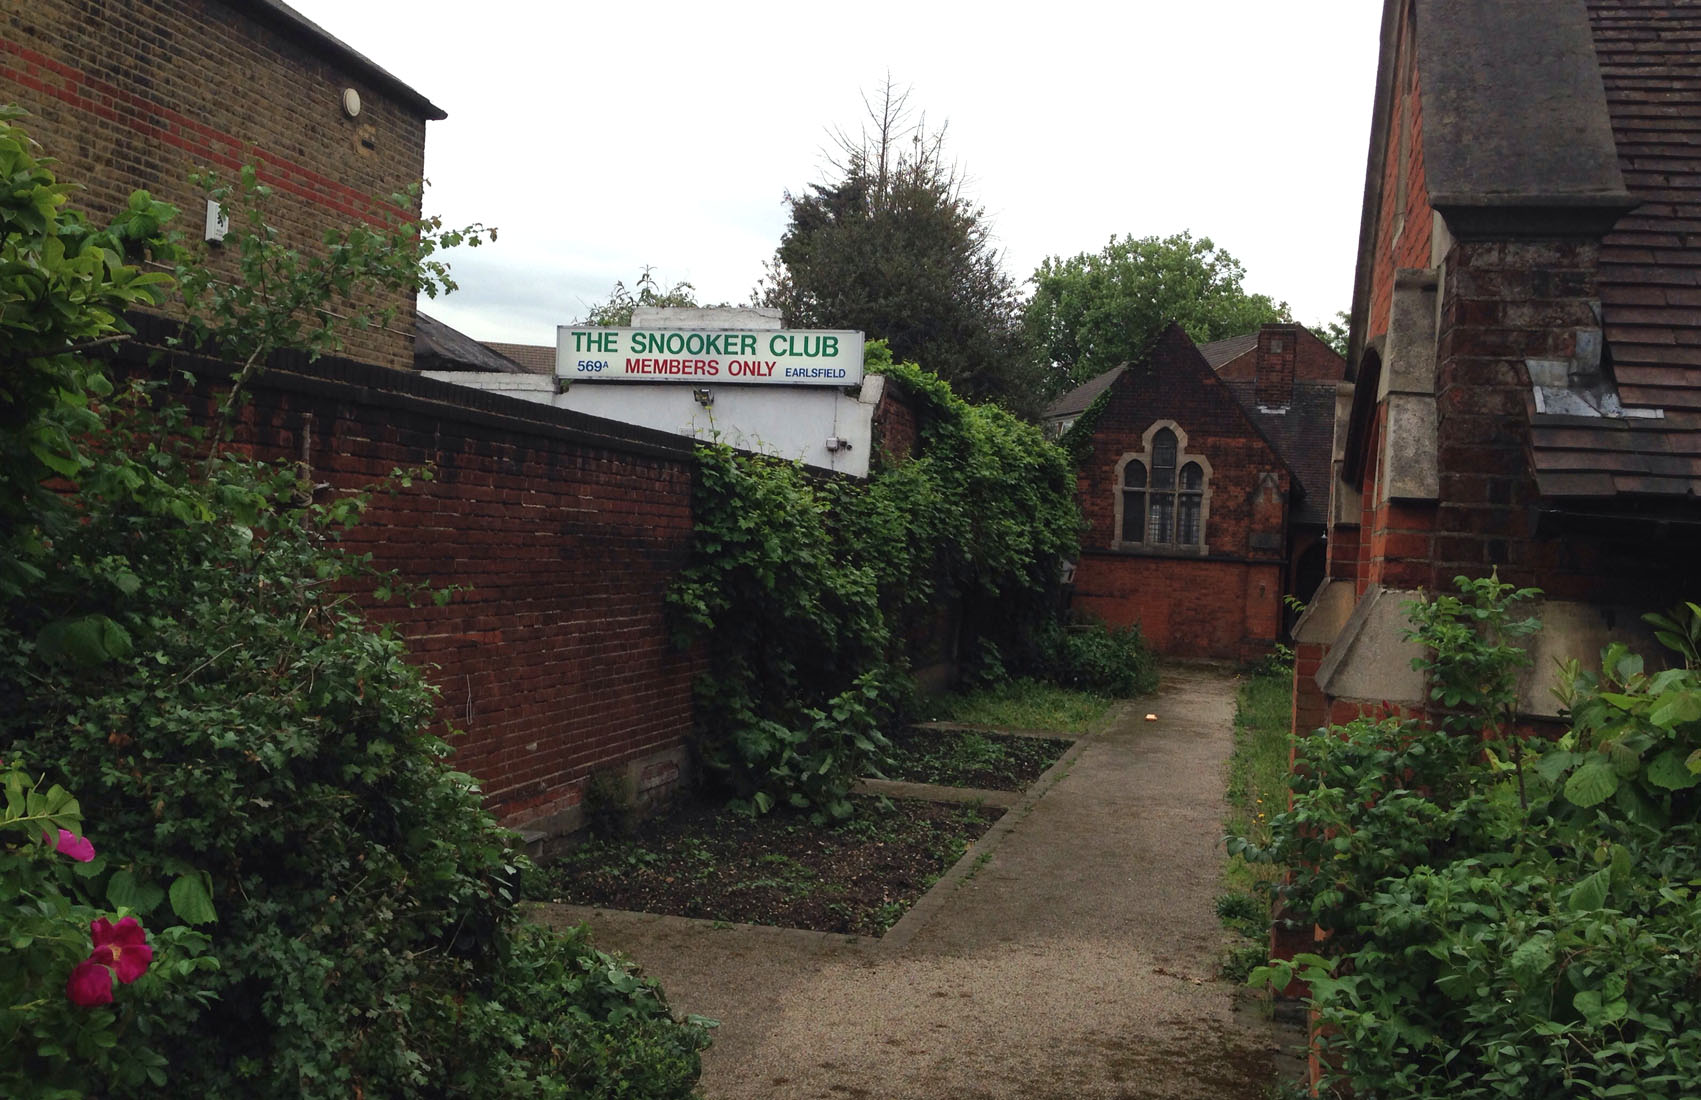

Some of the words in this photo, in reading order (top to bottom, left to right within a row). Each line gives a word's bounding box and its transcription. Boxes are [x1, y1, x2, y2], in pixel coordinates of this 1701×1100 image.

[571, 332, 619, 353] THE
[630, 332, 757, 356] SNOOKER
[769, 334, 839, 358] CLUB
[577, 360, 609, 373] 569A
[625, 358, 719, 376] MEMBERS
[728, 360, 777, 377] ONLY
[785, 367, 846, 379] EARLSFIELD
